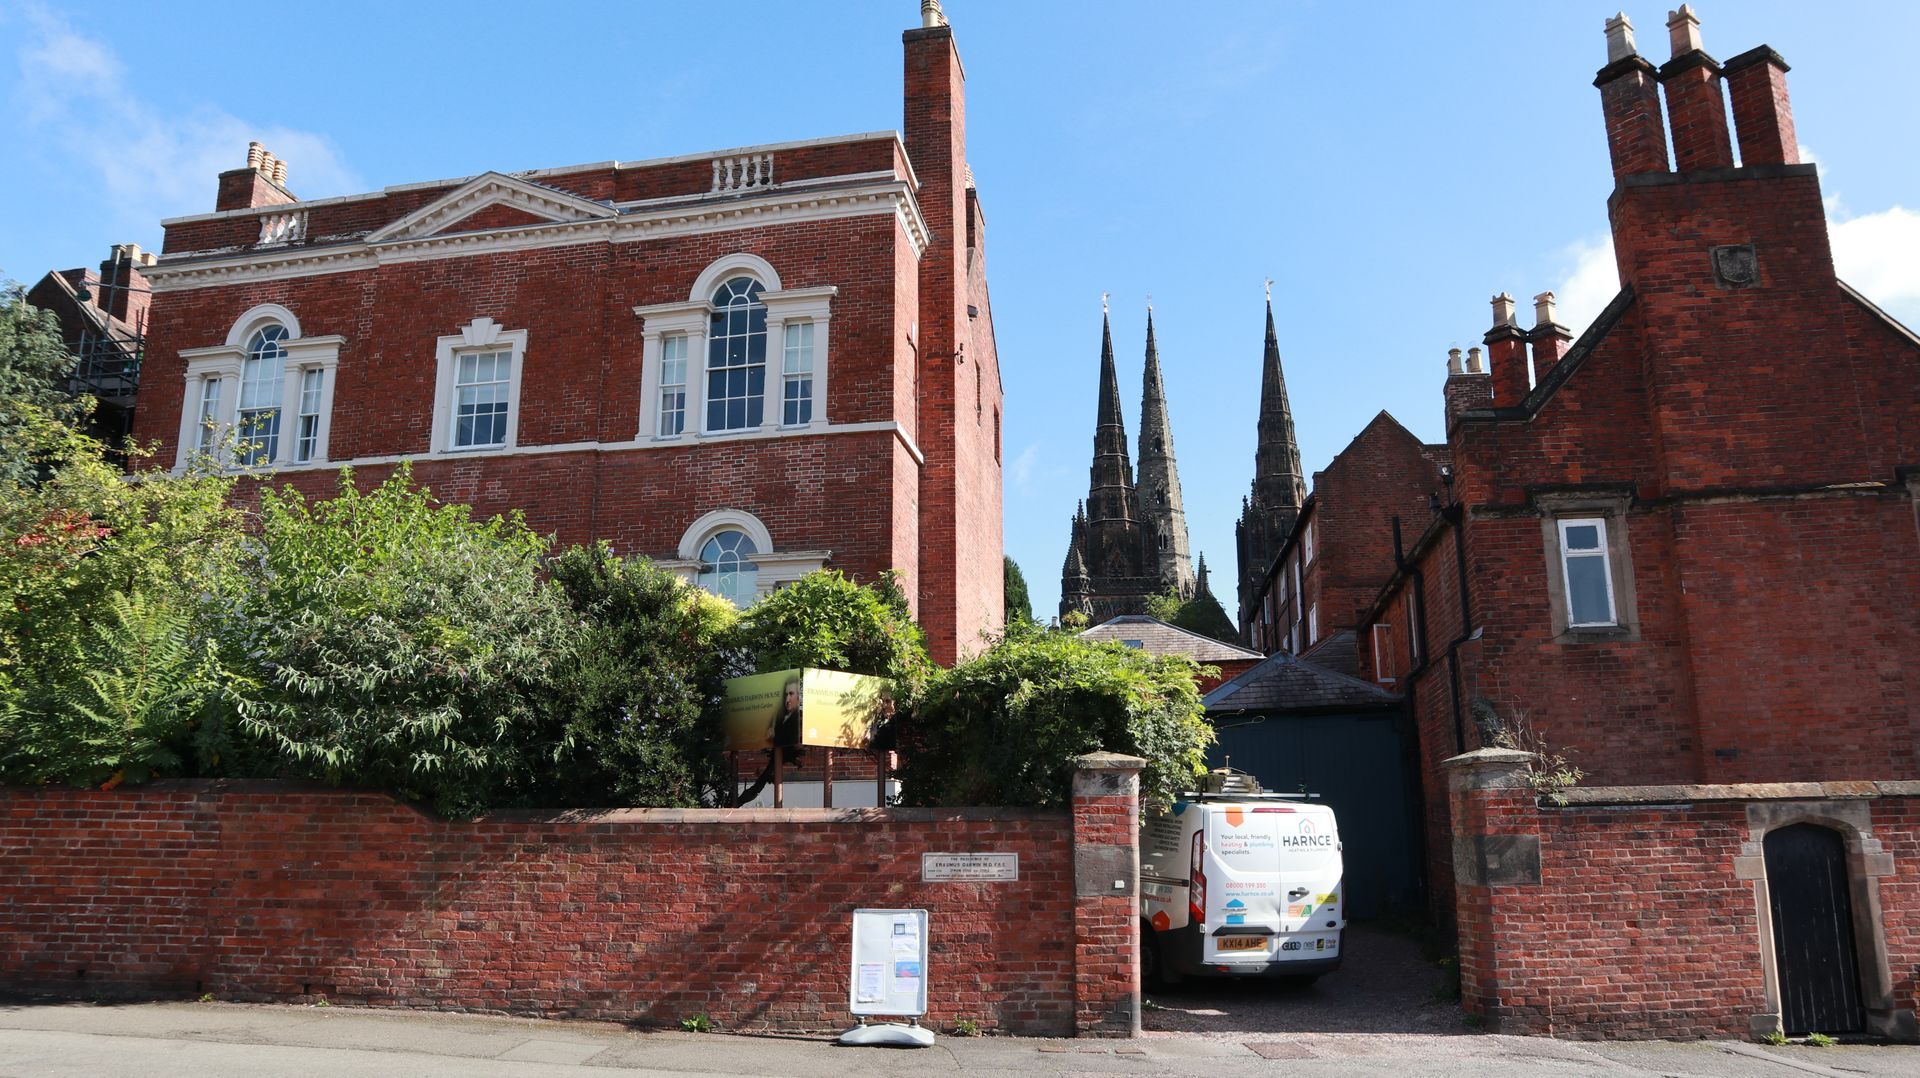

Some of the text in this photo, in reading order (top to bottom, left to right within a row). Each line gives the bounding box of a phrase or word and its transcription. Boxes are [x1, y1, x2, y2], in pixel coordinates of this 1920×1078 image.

[744, 694, 763, 702] DARWIN
[1283, 835, 1331, 846] HARNCE
[1223, 938, 1263, 949] KX14 AHE
